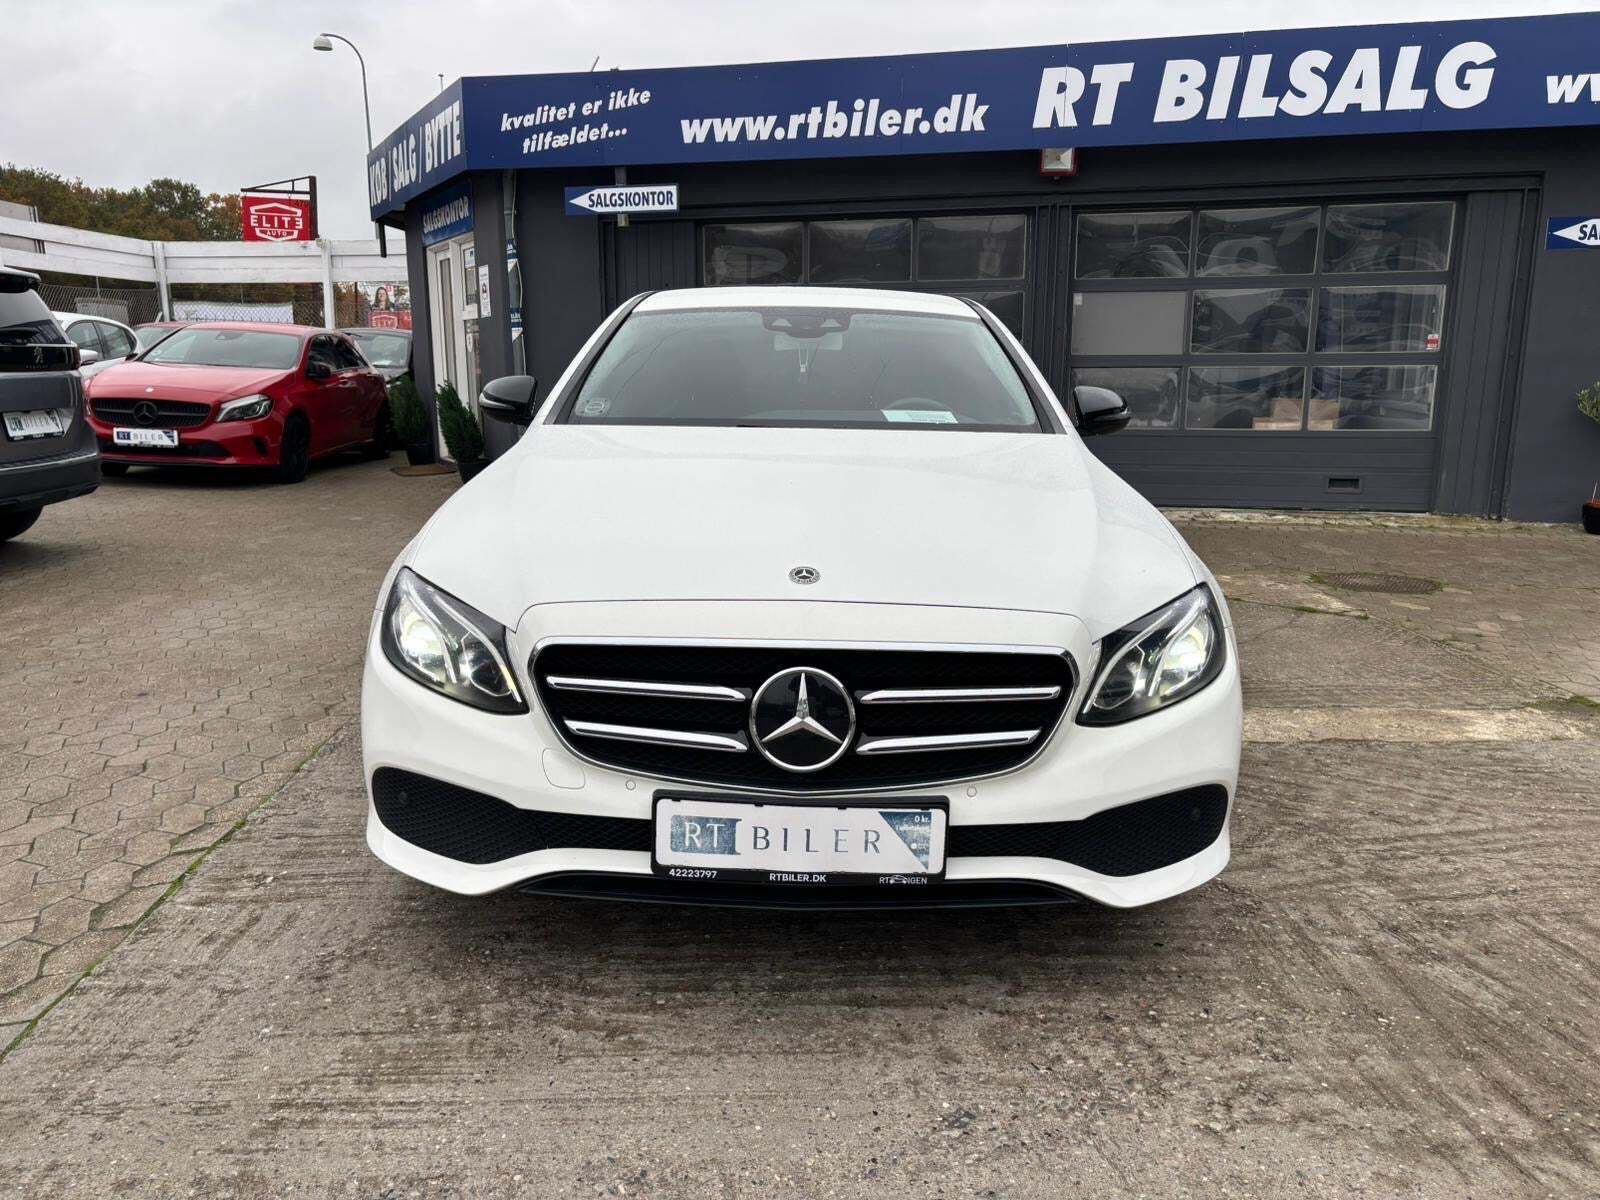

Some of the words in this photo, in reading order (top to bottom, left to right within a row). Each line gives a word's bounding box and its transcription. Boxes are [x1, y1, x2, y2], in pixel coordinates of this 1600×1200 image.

[1032, 62, 1135, 129] RT
[1153, 41, 1497, 123] BILSALG
[501, 102, 576, 132] kvalitet
[582, 99, 603, 116] er
[608, 88, 651, 112] ikke
[680, 93, 990, 144] www.rtbiler.dk
[392, 134, 417, 193] SALG
[425, 100, 461, 173] BYTTE
[523, 121, 628, 154] tilfældet...
[423, 195, 469, 234] SALGSKONTOR
[588, 189, 674, 208] SALGSKONTOR
[250, 215, 304, 230] ELITE
[1578, 223, 1600, 241] SA
[684, 820, 728, 849] RT
[752, 825, 881, 854] BILER
[669, 868, 717, 879] 42223797
[769, 872, 827, 883] RTBILER.DK
